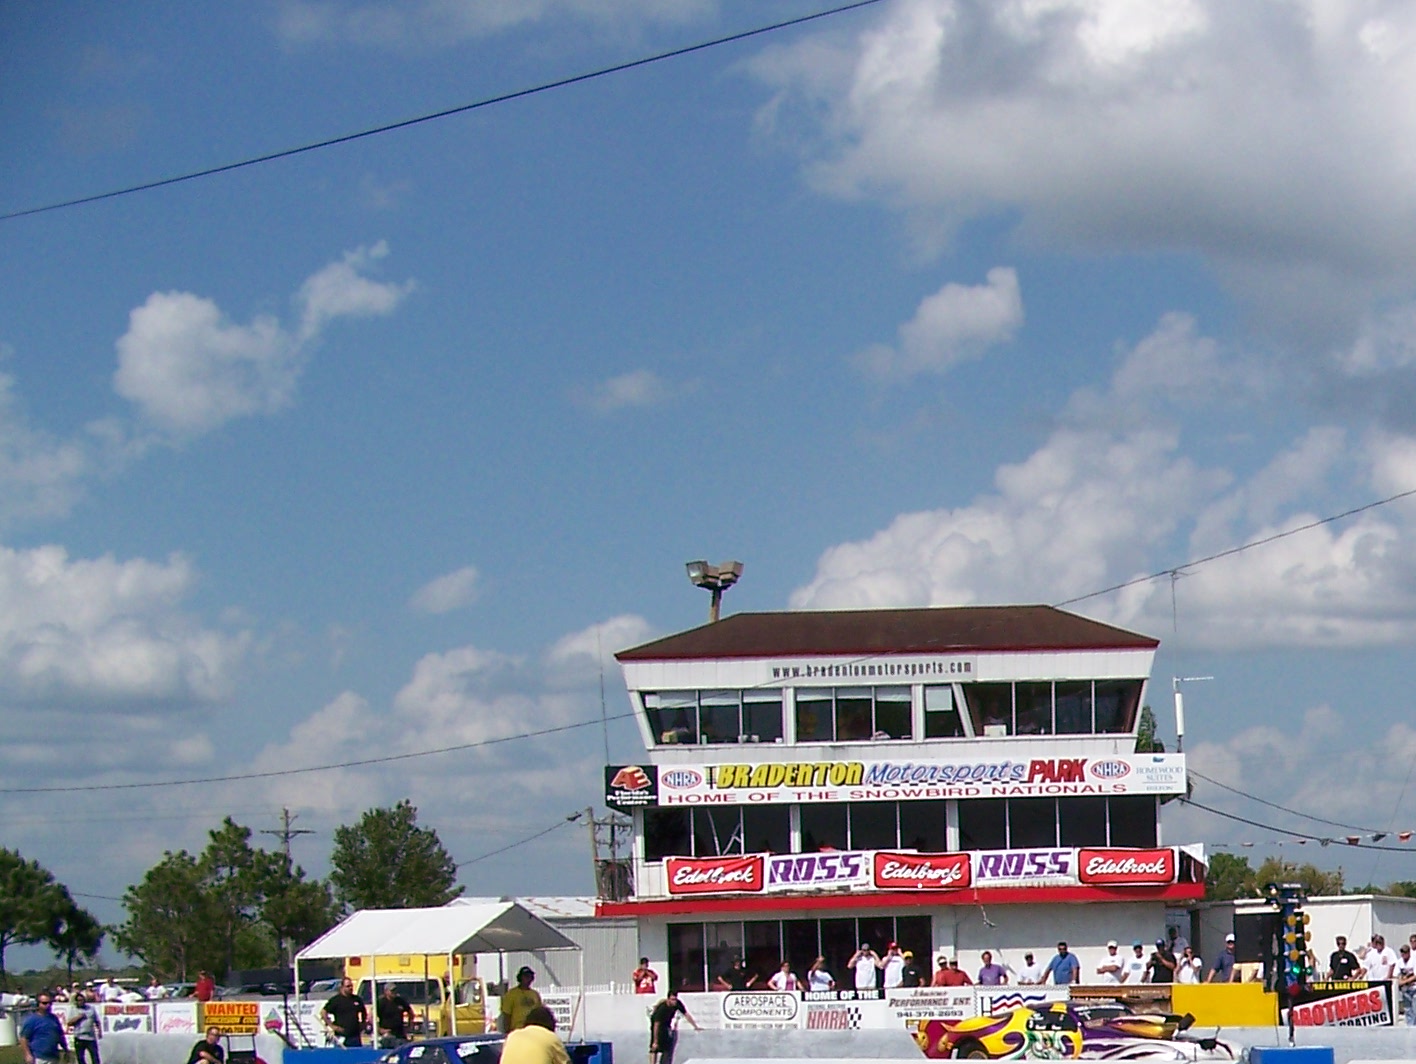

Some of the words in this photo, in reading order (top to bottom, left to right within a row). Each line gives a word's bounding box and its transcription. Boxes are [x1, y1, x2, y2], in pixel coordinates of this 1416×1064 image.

[772, 661, 972, 679] www.bradentonmotorsports.com
[866, 760, 1028, 786] Motorsports
[1027, 759, 1089, 783] PARK
[1093, 762, 1127, 778] NHRA
[665, 771, 701, 788] NHRA
[668, 793, 736, 804] HOME
[748, 792, 780, 801] OF
[792, 791, 838, 801] THE
[850, 786, 981, 800] SNOWBIRD
[992, 784, 1128, 796] NATIONALS
[769, 854, 863, 884] ROSS
[881, 860, 962, 885] Edelbrock
[977, 851, 1072, 878] ROSS
[1085, 857, 1167, 876] Edelbrock
[733, 995, 787, 1007] AEROSPACE
[805, 992, 838, 1000] HOME
[856, 990, 879, 999] THE
[207, 1003, 258, 1015] WANTED
[729, 1006, 793, 1016] COMPONENTS
[806, 1011, 848, 1030] NMRA
